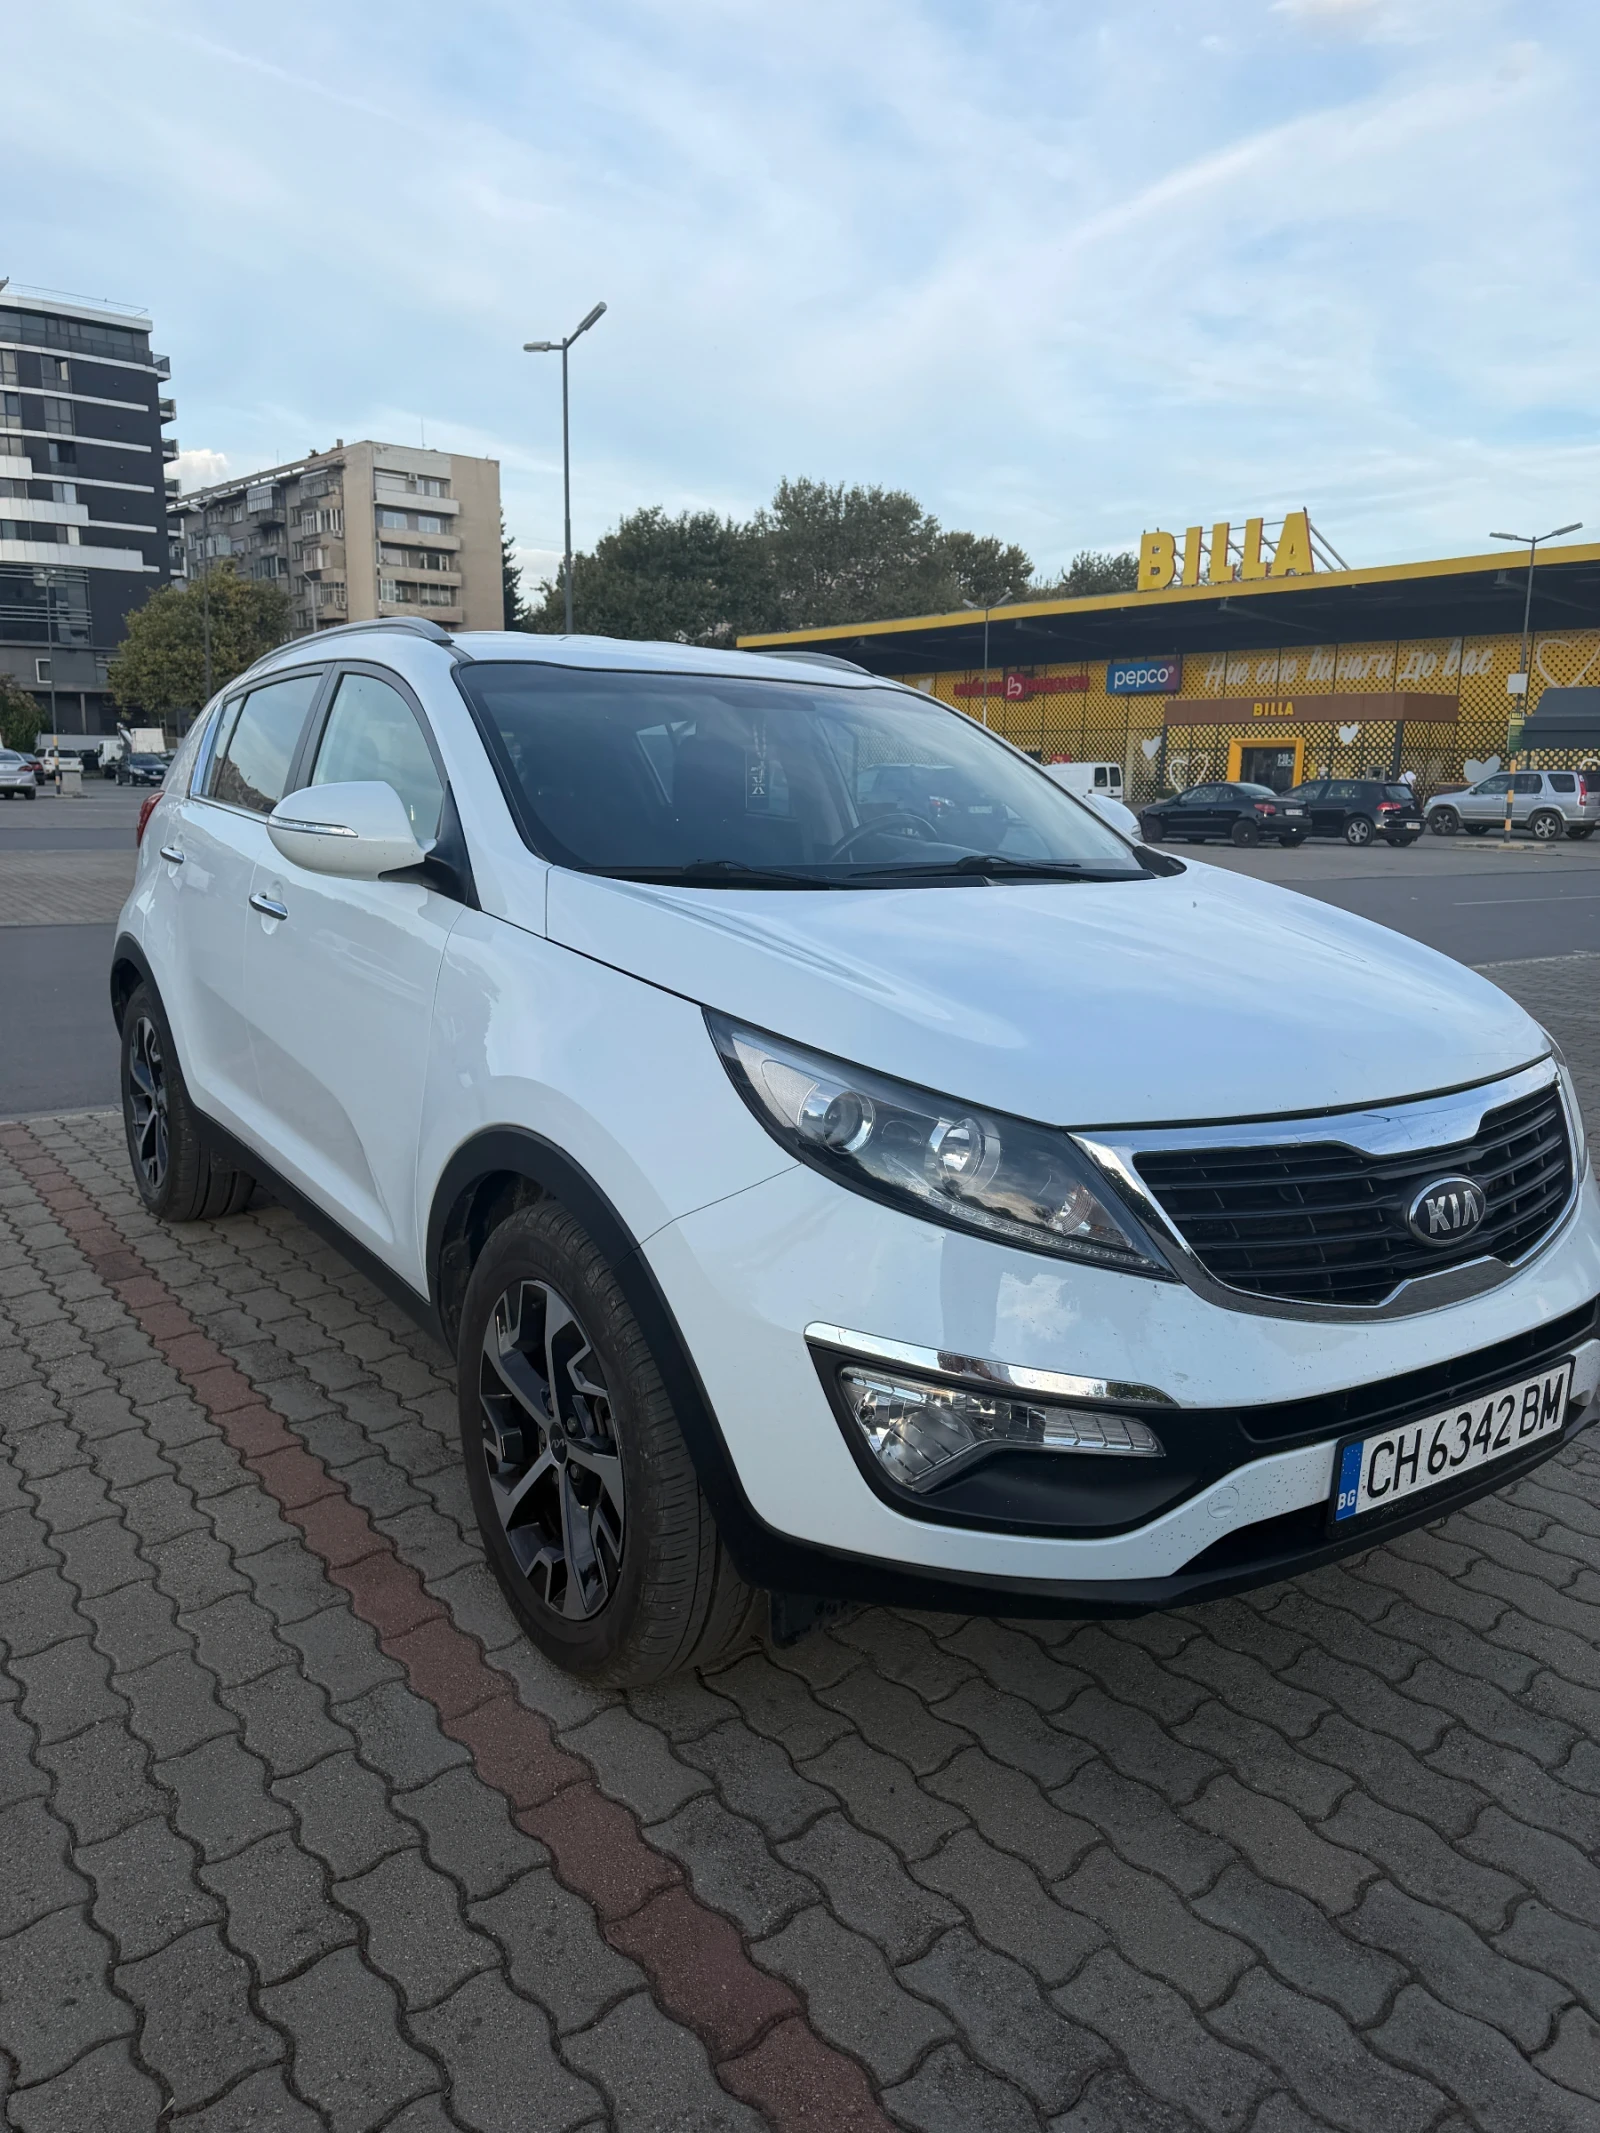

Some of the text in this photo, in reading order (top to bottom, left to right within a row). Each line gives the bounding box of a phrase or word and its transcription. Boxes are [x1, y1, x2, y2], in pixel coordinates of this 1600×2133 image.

[1137, 511, 1314, 591] BILLA
[1114, 667, 1169, 690] pepco
[1253, 701, 1294, 717] BILLA
[1425, 1190, 1479, 1233] KIA
[1336, 1489, 1356, 1511] BG
